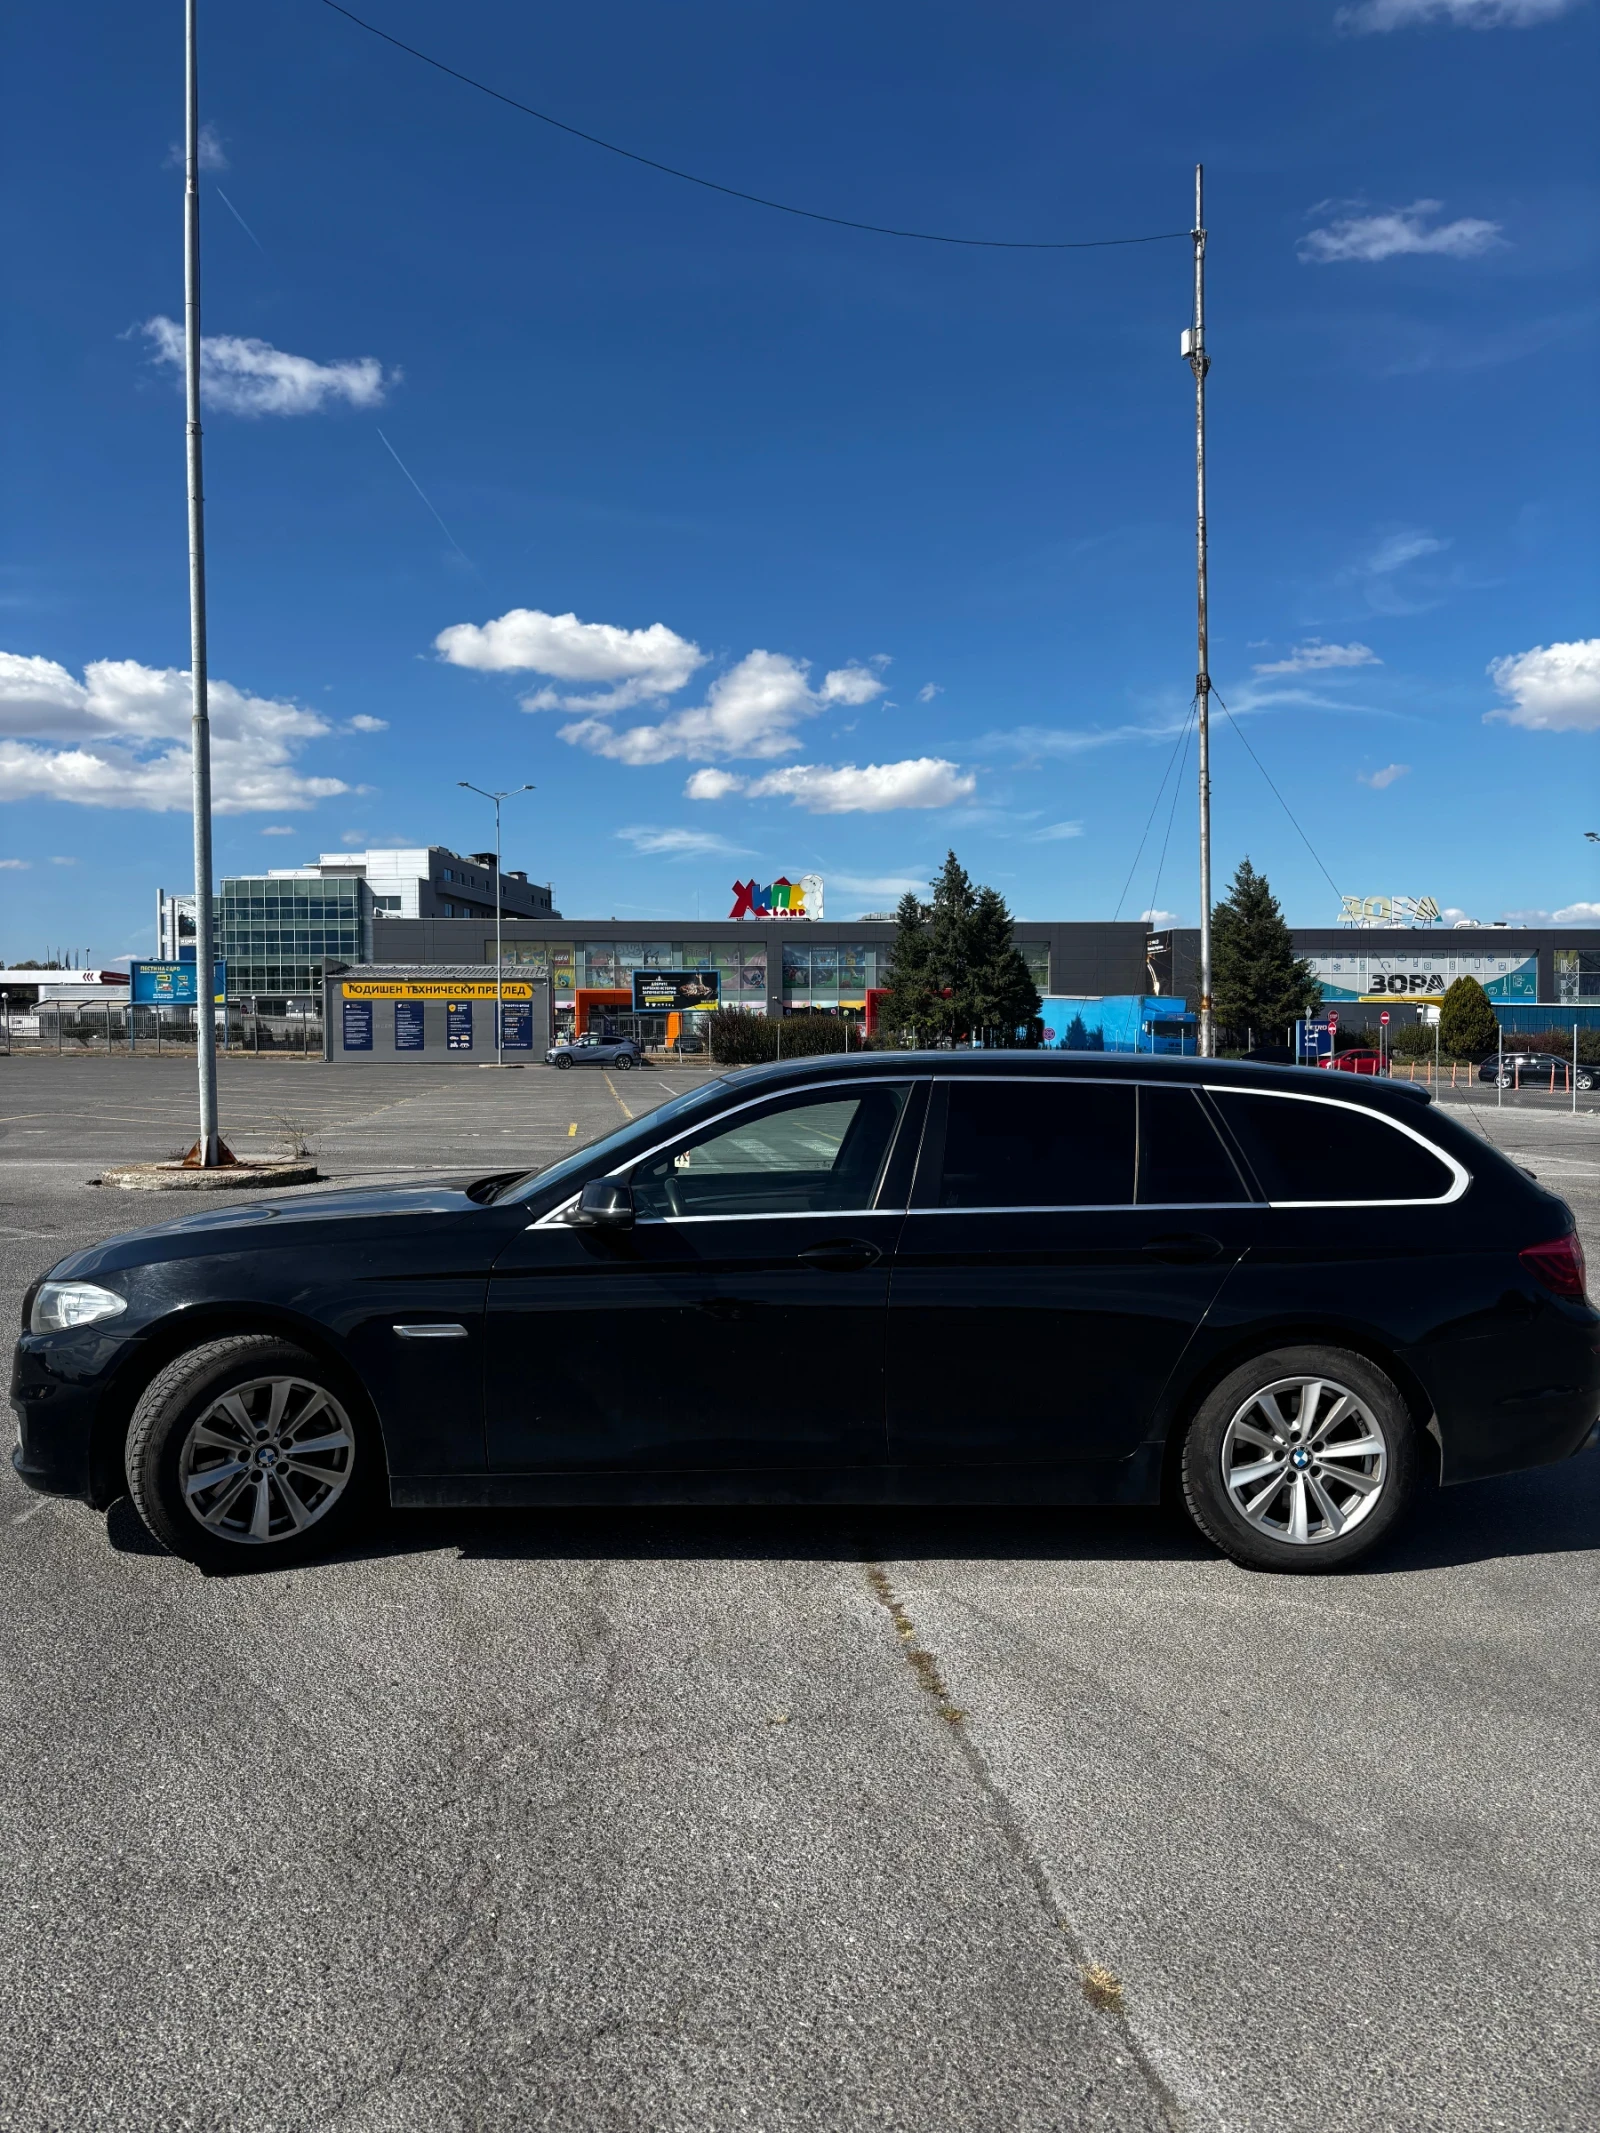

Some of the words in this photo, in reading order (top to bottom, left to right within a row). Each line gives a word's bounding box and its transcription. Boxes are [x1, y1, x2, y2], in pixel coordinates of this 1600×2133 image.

[773, 907, 806, 916] LAND
[1337, 896, 1443, 922] ЗОРА
[348, 985, 402, 995] ГОДИШЕН
[405, 985, 475, 995] ТЕХНИЧЕСКИ
[478, 986, 526, 996] ПРЕЛЕД
[1368, 975, 1446, 994] ЗОРА
